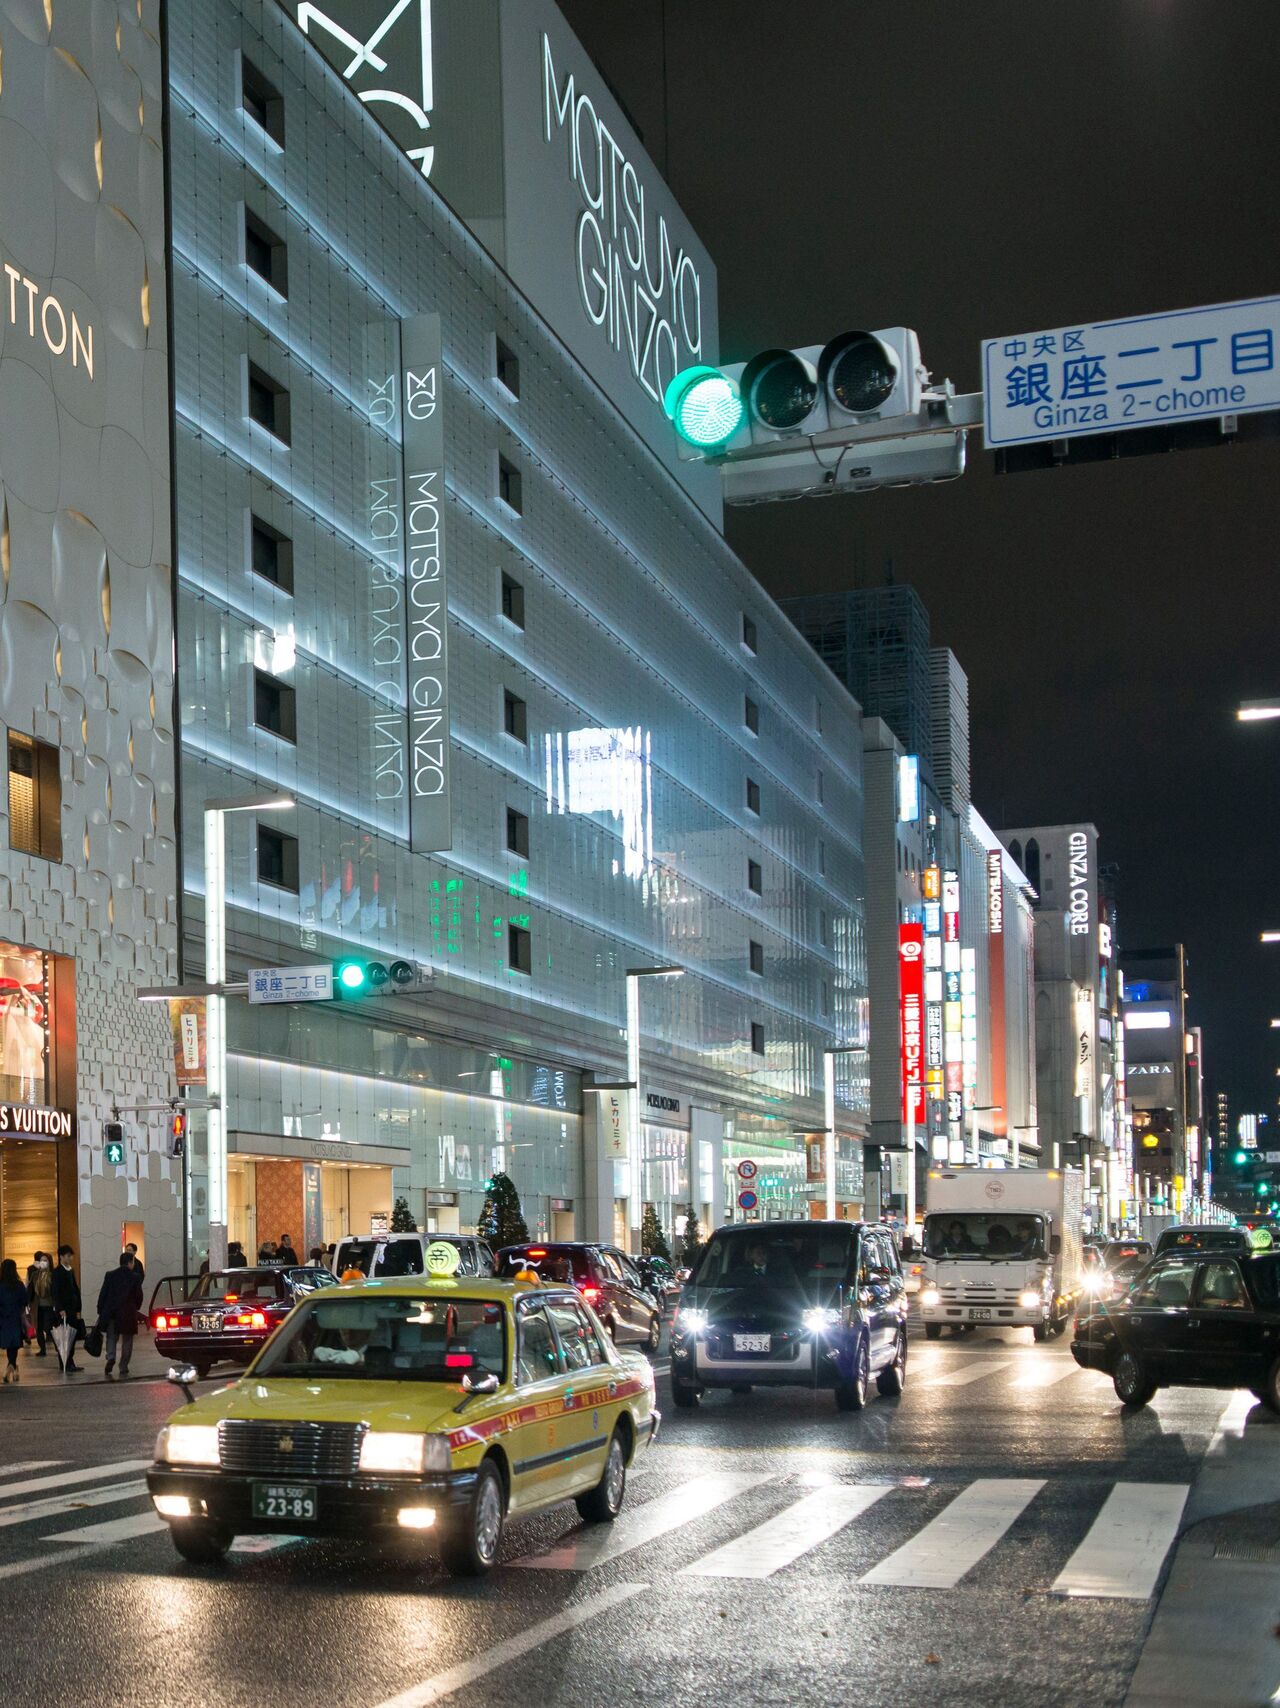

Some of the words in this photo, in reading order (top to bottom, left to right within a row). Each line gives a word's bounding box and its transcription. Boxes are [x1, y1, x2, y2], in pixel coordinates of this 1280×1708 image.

[1004, 329, 1086, 362] 中央区
[1005, 328, 1274, 409] 銀座二丁目
[1034, 403, 1109, 429] Ginza
[1122, 383, 1246, 417] 2-chome
[1068, 831, 1088, 888] GINZA
[989, 854, 1003, 933] MITSUKOSHI
[1069, 888, 1090, 936] CORE
[254, 968, 277, 977] 中央区
[255, 974, 327, 992] 銀座二丁目
[262, 991, 283, 999] Ginza
[286, 989, 320, 998] 2-chome
[185, 1017, 196, 1066] ヒカリミチ
[1127, 1065, 1173, 1076] ZARA
[12, 1107, 72, 1137] VUITTON
[610, 1096, 622, 1150] ヒカリミチ
[201, 1320, 220, 1330] 32-05
[742, 1341, 769, 1351] 52-36
[500, 1413, 521, 1431] TAXI
[266, 1497, 314, 1518] 23-89
